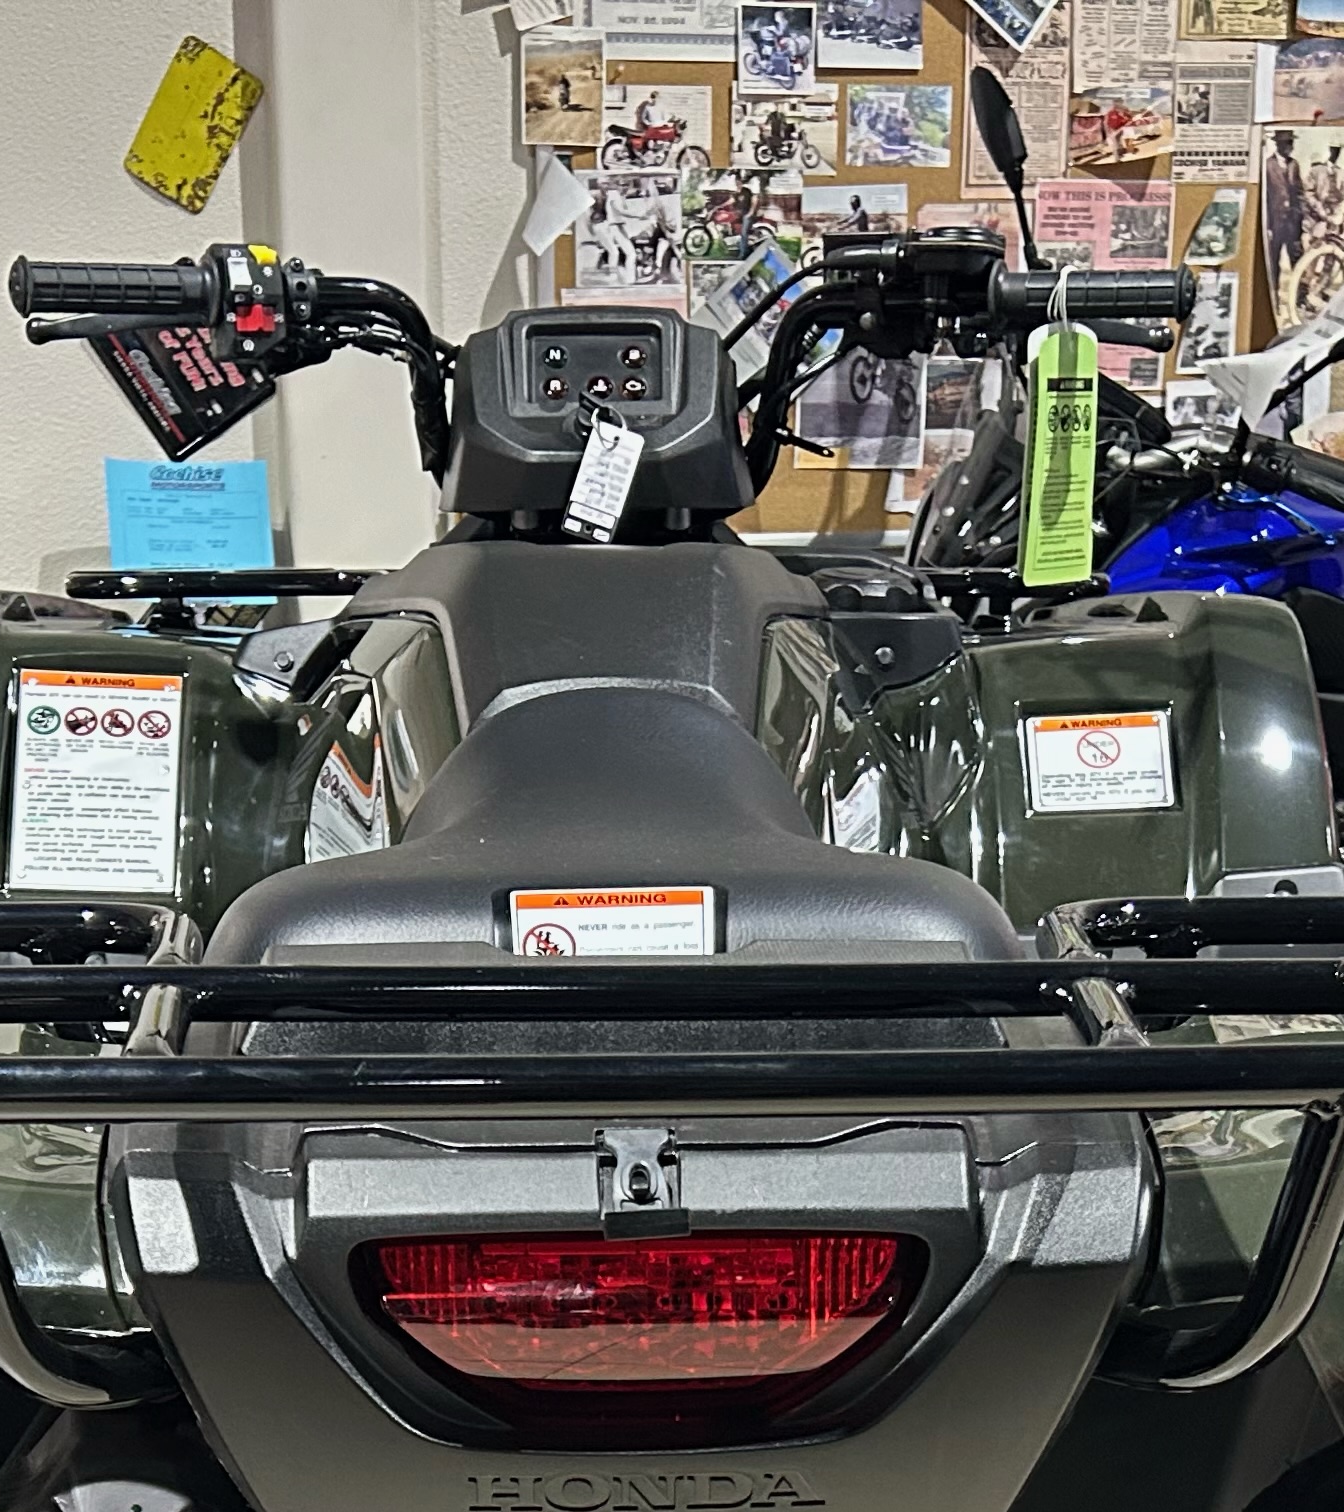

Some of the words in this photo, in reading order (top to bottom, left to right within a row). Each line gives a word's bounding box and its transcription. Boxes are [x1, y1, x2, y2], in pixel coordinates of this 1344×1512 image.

[549, 349, 561, 361] N
[150, 465, 225, 481] Cochise
[81, 676, 136, 688] WARNING
[1070, 718, 1122, 728] WARNING
[576, 893, 667, 905] WARNING
[578, 923, 607, 931] NEVER
[466, 1471, 827, 1512] HONDA
